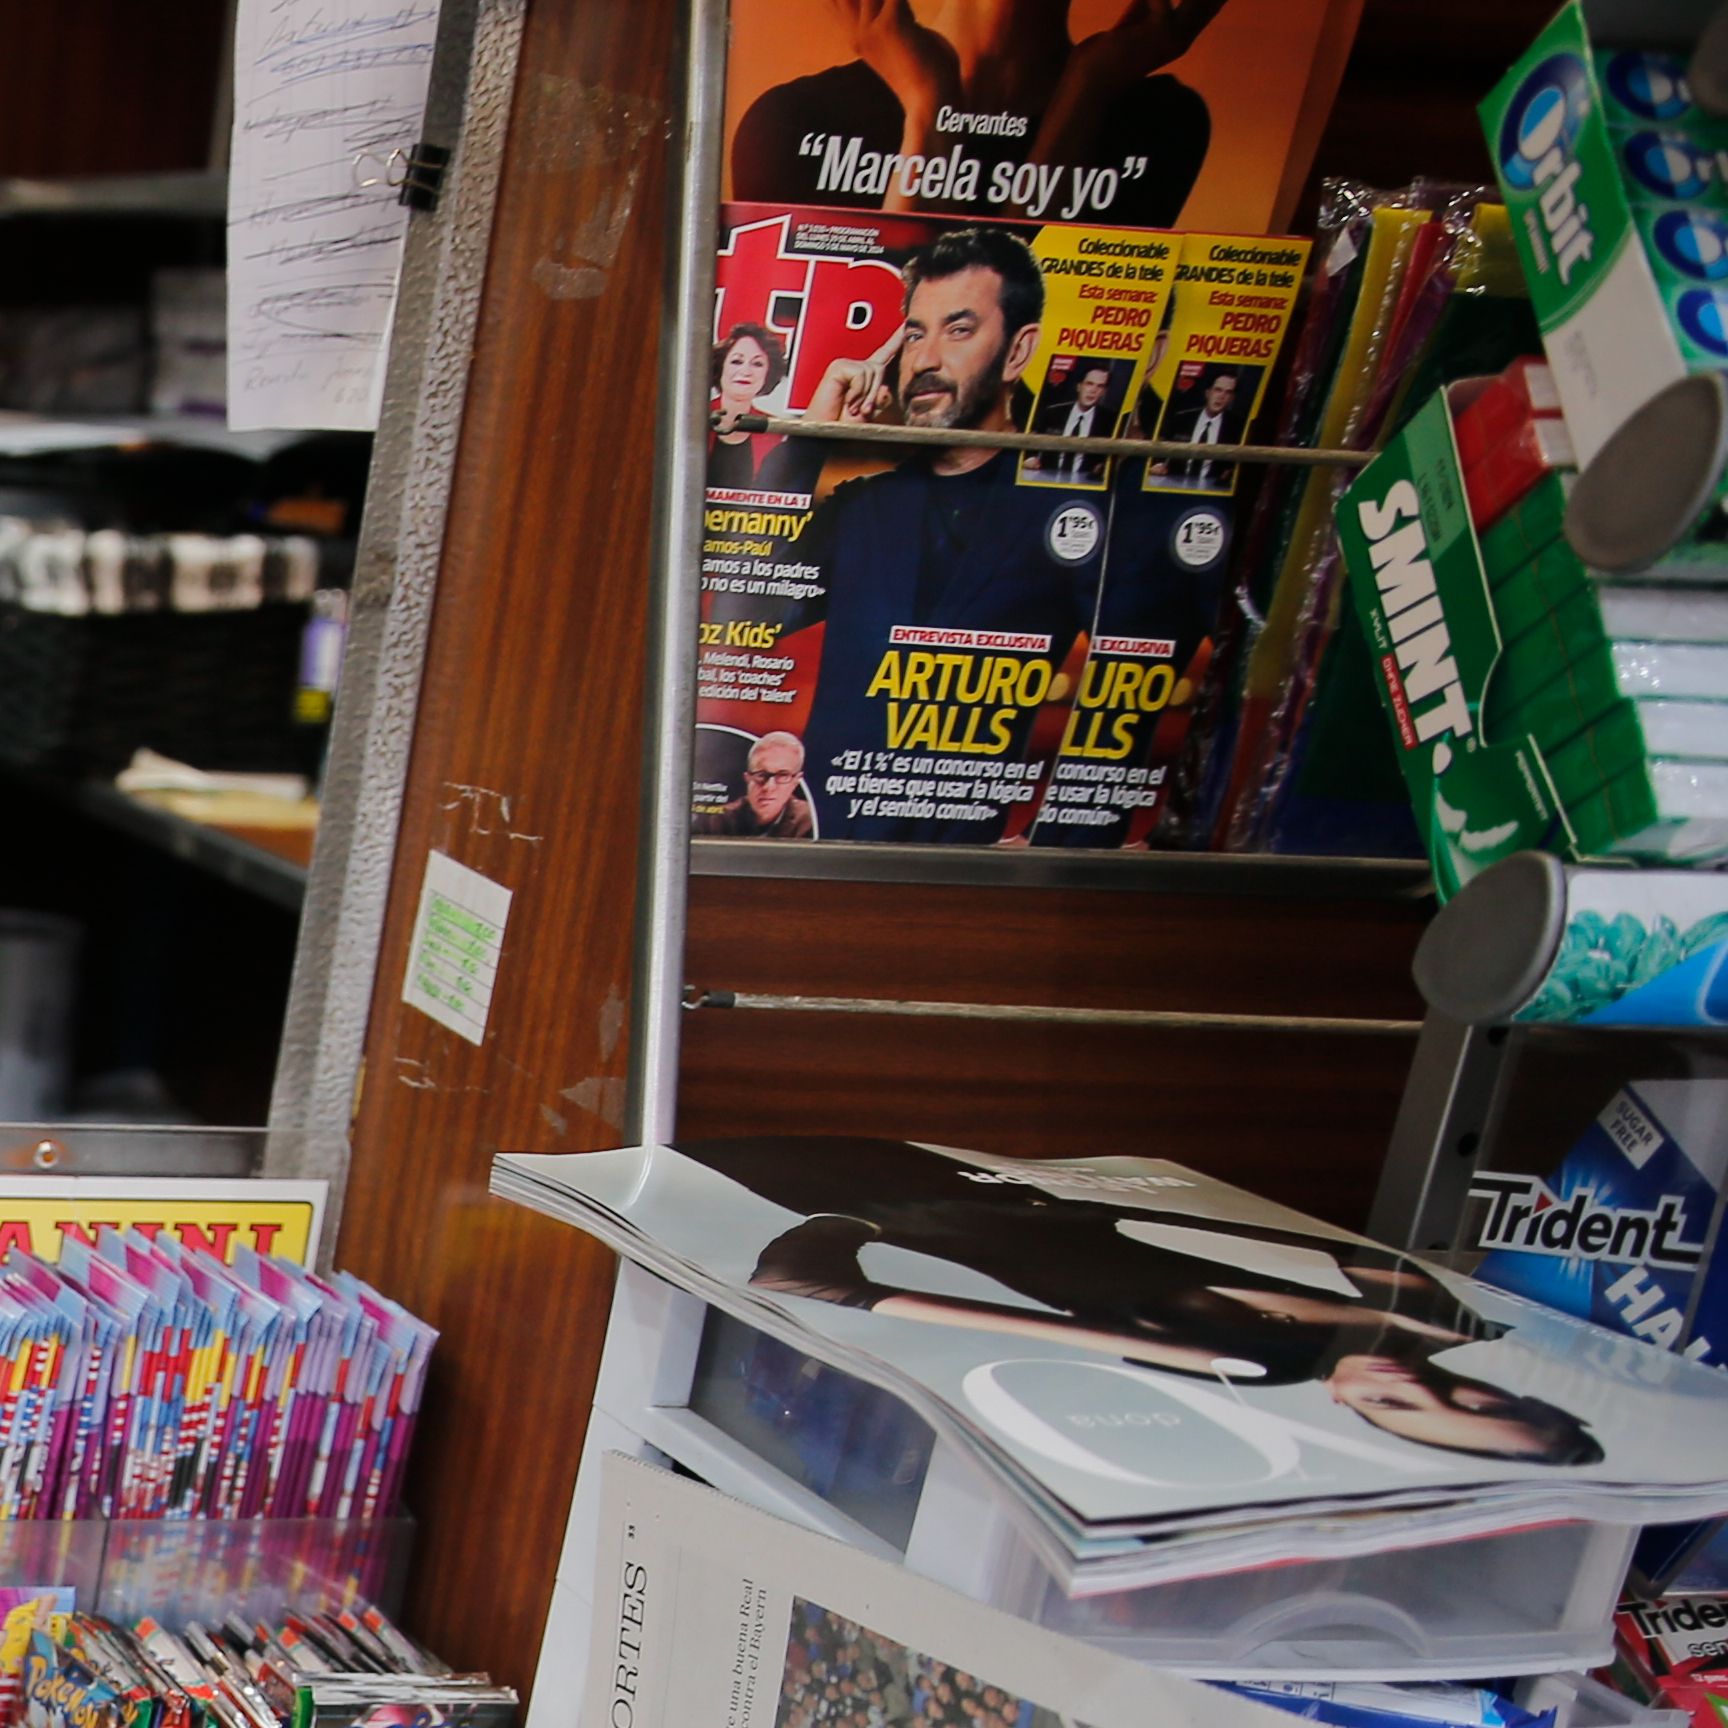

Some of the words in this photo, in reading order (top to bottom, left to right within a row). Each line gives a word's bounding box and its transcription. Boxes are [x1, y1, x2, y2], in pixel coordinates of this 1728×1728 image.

[936, 105, 1028, 137] Cervantes
[1497, 50, 1597, 286] Orbit
[988, 160, 1062, 218] soy
[1077, 237, 1170, 261] Coleccionable
[1208, 244, 1302, 268] Coleccionable
[1041, 257, 1104, 279] GRANDES
[1106, 261, 1122, 279] de
[1139, 263, 1164, 282] tele
[1271, 270, 1295, 289] tele
[1078, 283, 1109, 300] Esta
[1109, 286, 1158, 304] semana:
[1091, 305, 1152, 328] PEDRO
[1221, 312, 1282, 335] PEDRO
[1057, 329, 1144, 353] PIQUERAS
[1186, 335, 1274, 359] PIQUERAS
[773, 562, 820, 580] padres
[1357, 479, 1472, 740] SMINT
[725, 621, 783, 648] Kids’
[893, 628, 971, 647] ENTREVISTA
[976, 633, 1047, 651] EXCLUSIVA
[1099, 639, 1173, 656] EXCLUSIVA
[865, 651, 1052, 708] ARTURO
[885, 703, 1018, 756] VALLS
[934, 759, 1005, 778] concurso
[1057, 763, 1125, 782] concurso
[857, 773, 902, 793] tienes
[938, 777, 969, 795] usar
[988, 777, 1034, 802] lógica
[877, 797, 934, 819] sentido
[1614, 1100, 1655, 1146] SUGAR
[1610, 1120, 1641, 1154] FREE
[1470, 1172, 1704, 1266] Trident
[740, 1578, 754, 1618] Real
[750, 1588, 767, 1652] Bayern
[1616, 1600, 1728, 1639] Tride
[733, 1619, 749, 1674] buena
